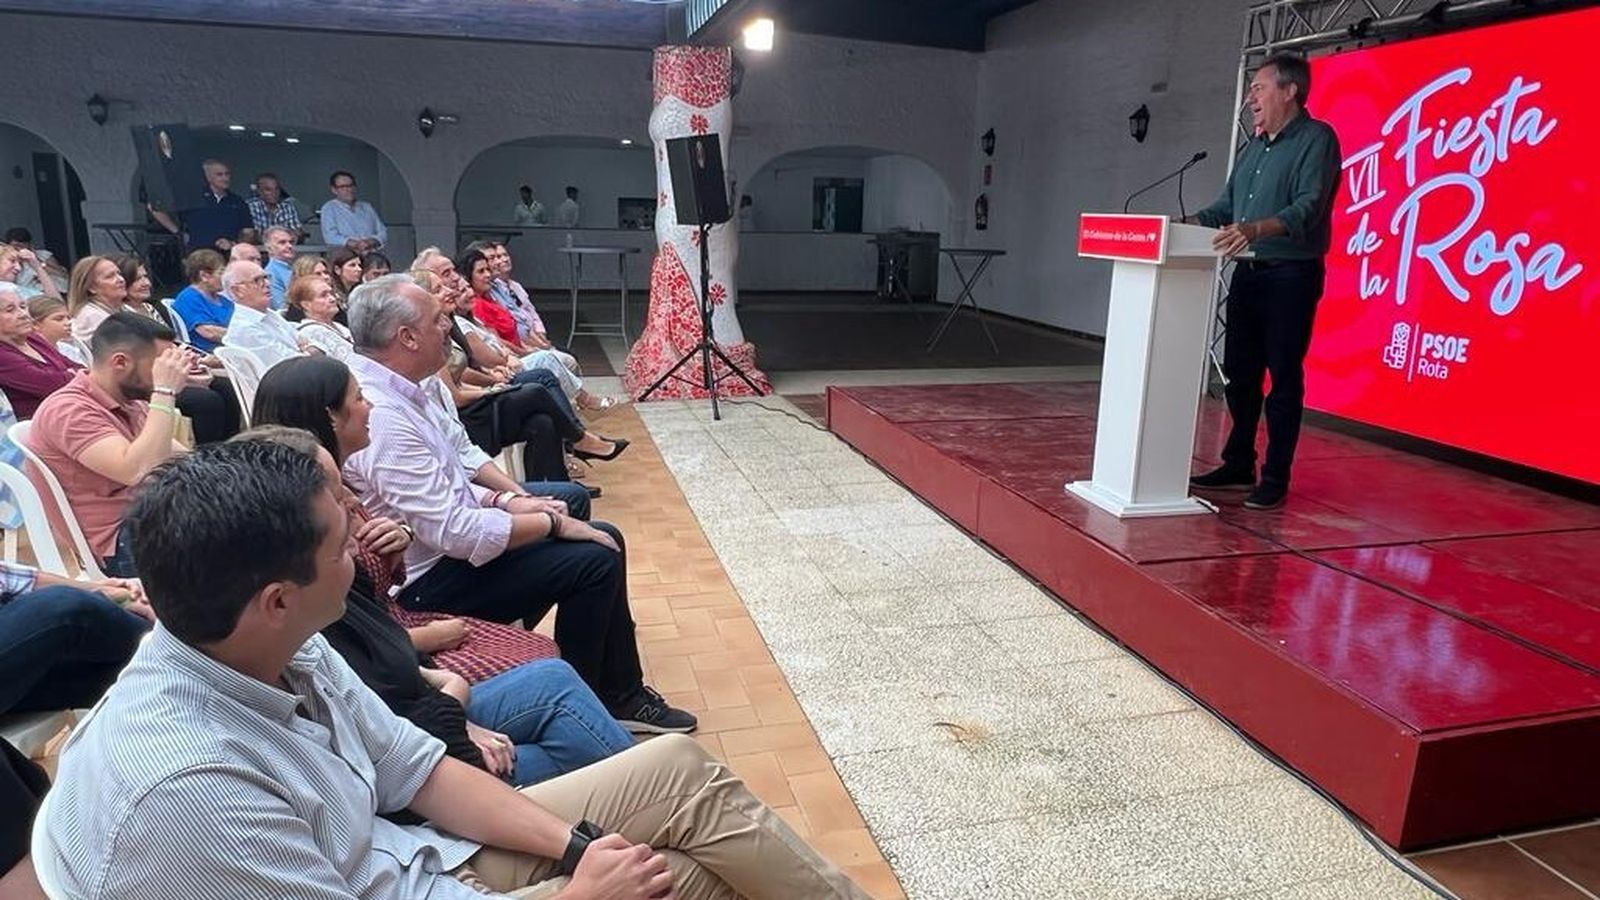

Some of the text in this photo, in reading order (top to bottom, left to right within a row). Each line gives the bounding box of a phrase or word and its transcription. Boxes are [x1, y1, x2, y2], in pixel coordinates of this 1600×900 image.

[1341, 67, 1557, 214] VII Fiesta
[1347, 212, 1383, 255] de
[1390, 172, 1583, 317] Rosa
[1360, 258, 1390, 300] la
[1417, 357, 1448, 379] Rota
[1421, 332, 1470, 363] PSOE
